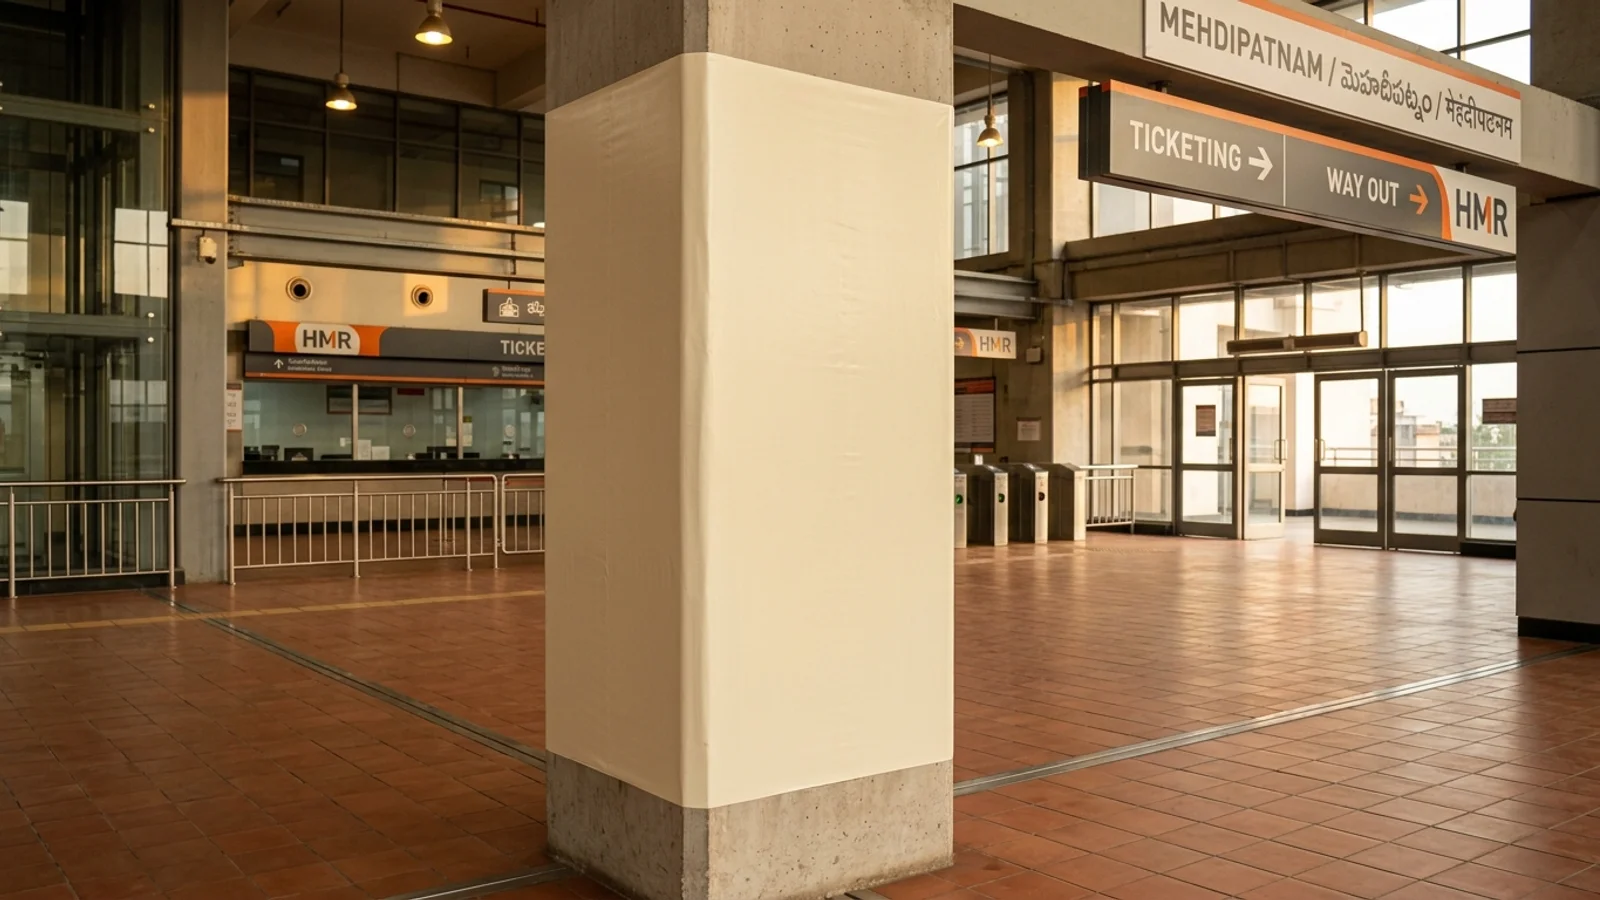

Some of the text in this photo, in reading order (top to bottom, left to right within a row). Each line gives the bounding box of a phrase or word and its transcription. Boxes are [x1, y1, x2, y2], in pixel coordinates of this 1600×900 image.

[1160, 1, 1323, 82] MEHDIPATNAM
[1327, 56, 1337, 87] /
[1435, 91, 1443, 121] /
[1129, 119, 1241, 172] TICKETING
[1326, 166, 1400, 207] WAY OUT
[1455, 188, 1509, 238] HMR
[303, 328, 352, 350] HMR
[500, 339, 545, 356] TICKE
[979, 335, 1012, 353] HMR
